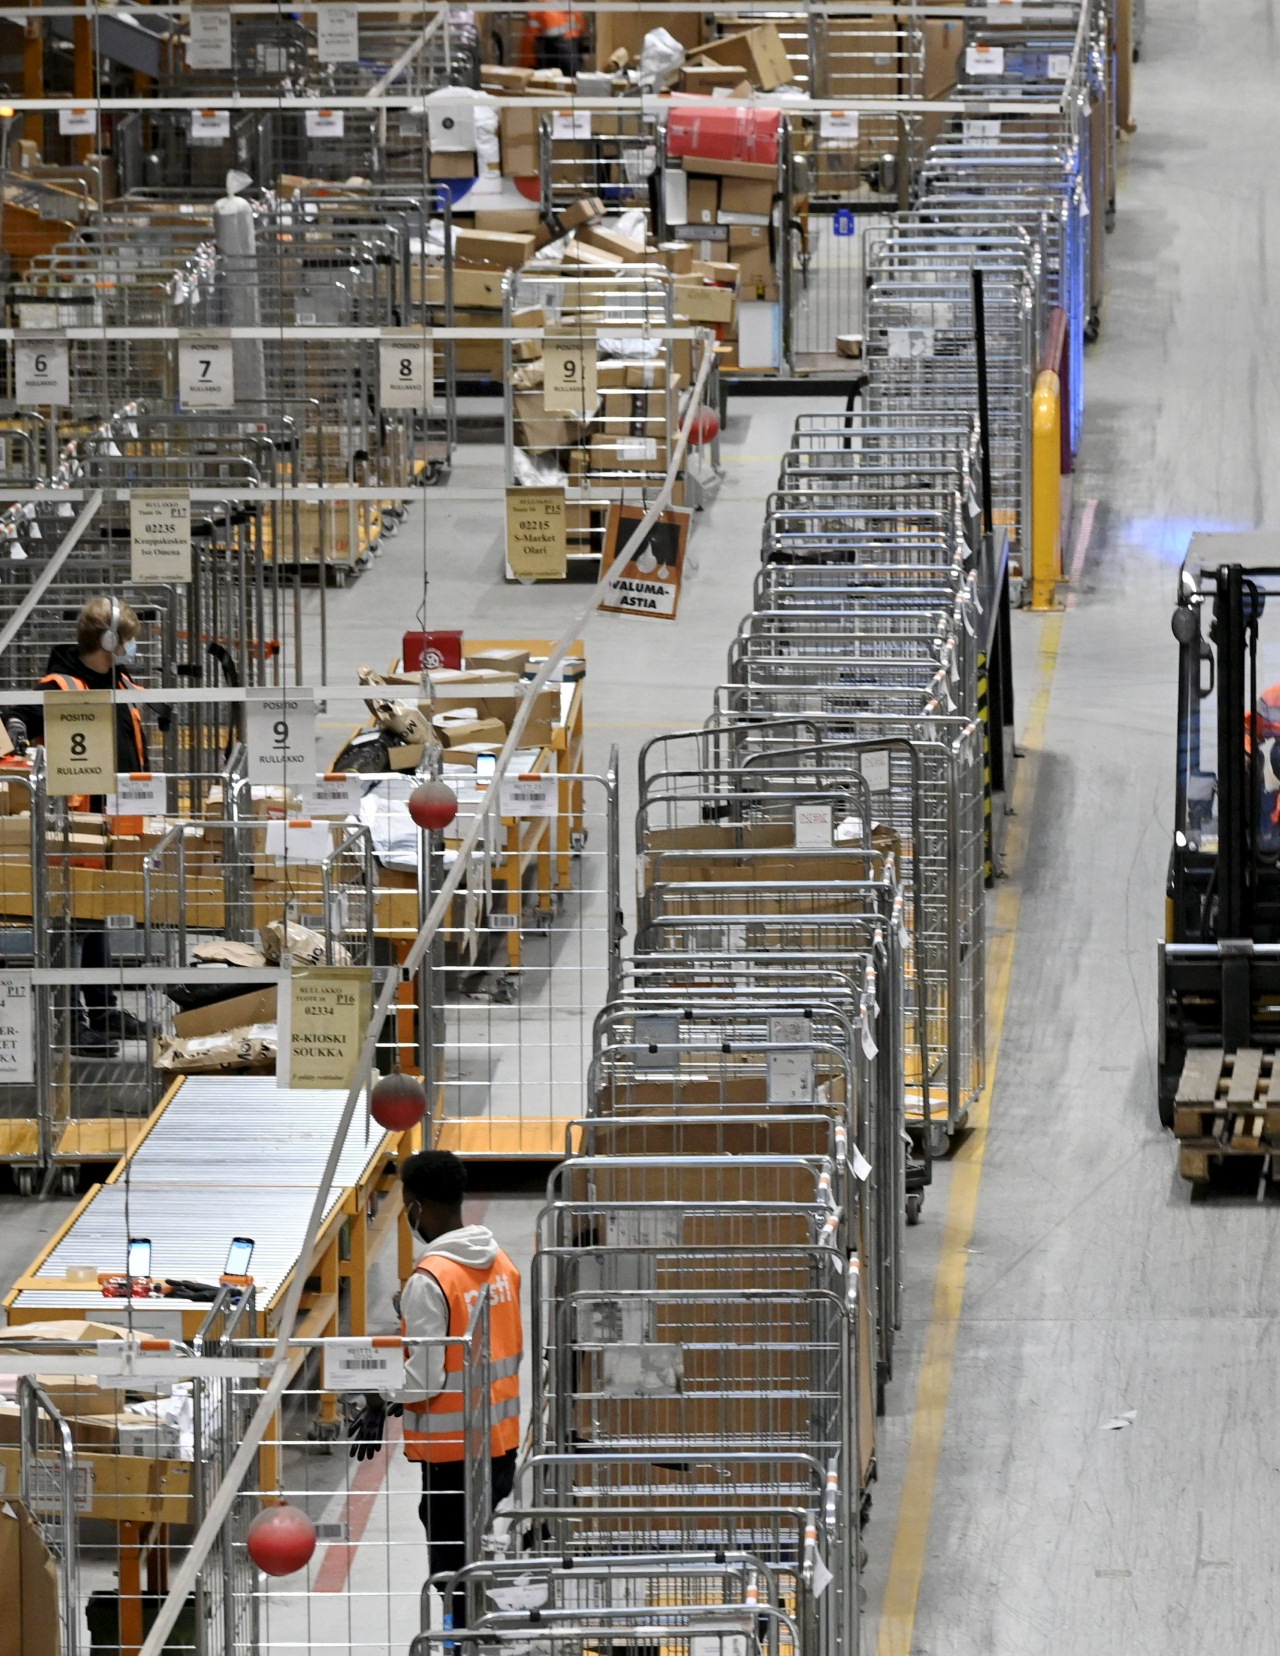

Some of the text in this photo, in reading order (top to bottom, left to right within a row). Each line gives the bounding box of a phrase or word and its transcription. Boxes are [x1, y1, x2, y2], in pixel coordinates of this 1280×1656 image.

[35, 354, 47, 372] 6
[399, 358, 412, 376] 8
[199, 360, 212, 378] 7
[563, 360, 576, 378] 9
[145, 523, 176, 533] 02235
[519, 521, 550, 530] 02215
[134, 538, 188, 546] Kauppakeskus
[514, 534, 556, 542] S-Market
[523, 546, 547, 554] Olari
[609, 580, 669, 596] VALUMA-
[620, 595, 657, 609] ASTIA
[263, 702, 298, 710] POSITIO
[60, 713, 95, 721] POSITIO
[273, 721, 289, 743] 9
[71, 733, 86, 755] 8
[259, 755, 304, 763] RULLAKKO
[57, 767, 102, 775] RULLAKKO
[8, 986, 26, 995] P17
[336, 994, 355, 1004] P16
[304, 1006, 334, 1016] 02334
[291, 1034, 346, 1043] R-KIOSKI
[293, 1047, 344, 1057] SOUKKA
[464, 1273, 512, 1314] psti
